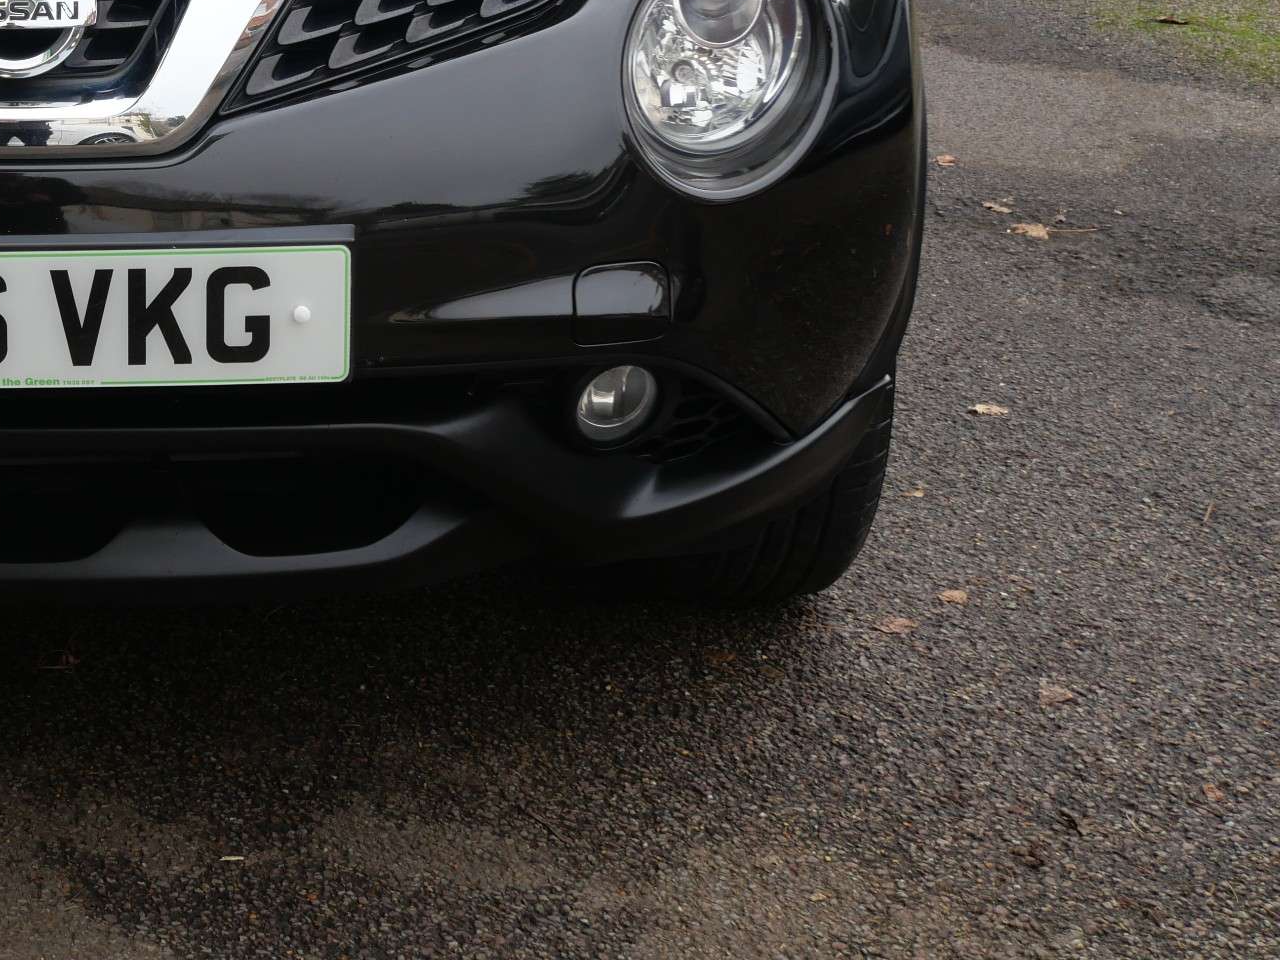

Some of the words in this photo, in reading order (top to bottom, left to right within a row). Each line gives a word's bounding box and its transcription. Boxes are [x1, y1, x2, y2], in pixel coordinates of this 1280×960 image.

[49, 265, 271, 365] VKG
[2, 377, 21, 387] the
[24, 376, 61, 386] Green
